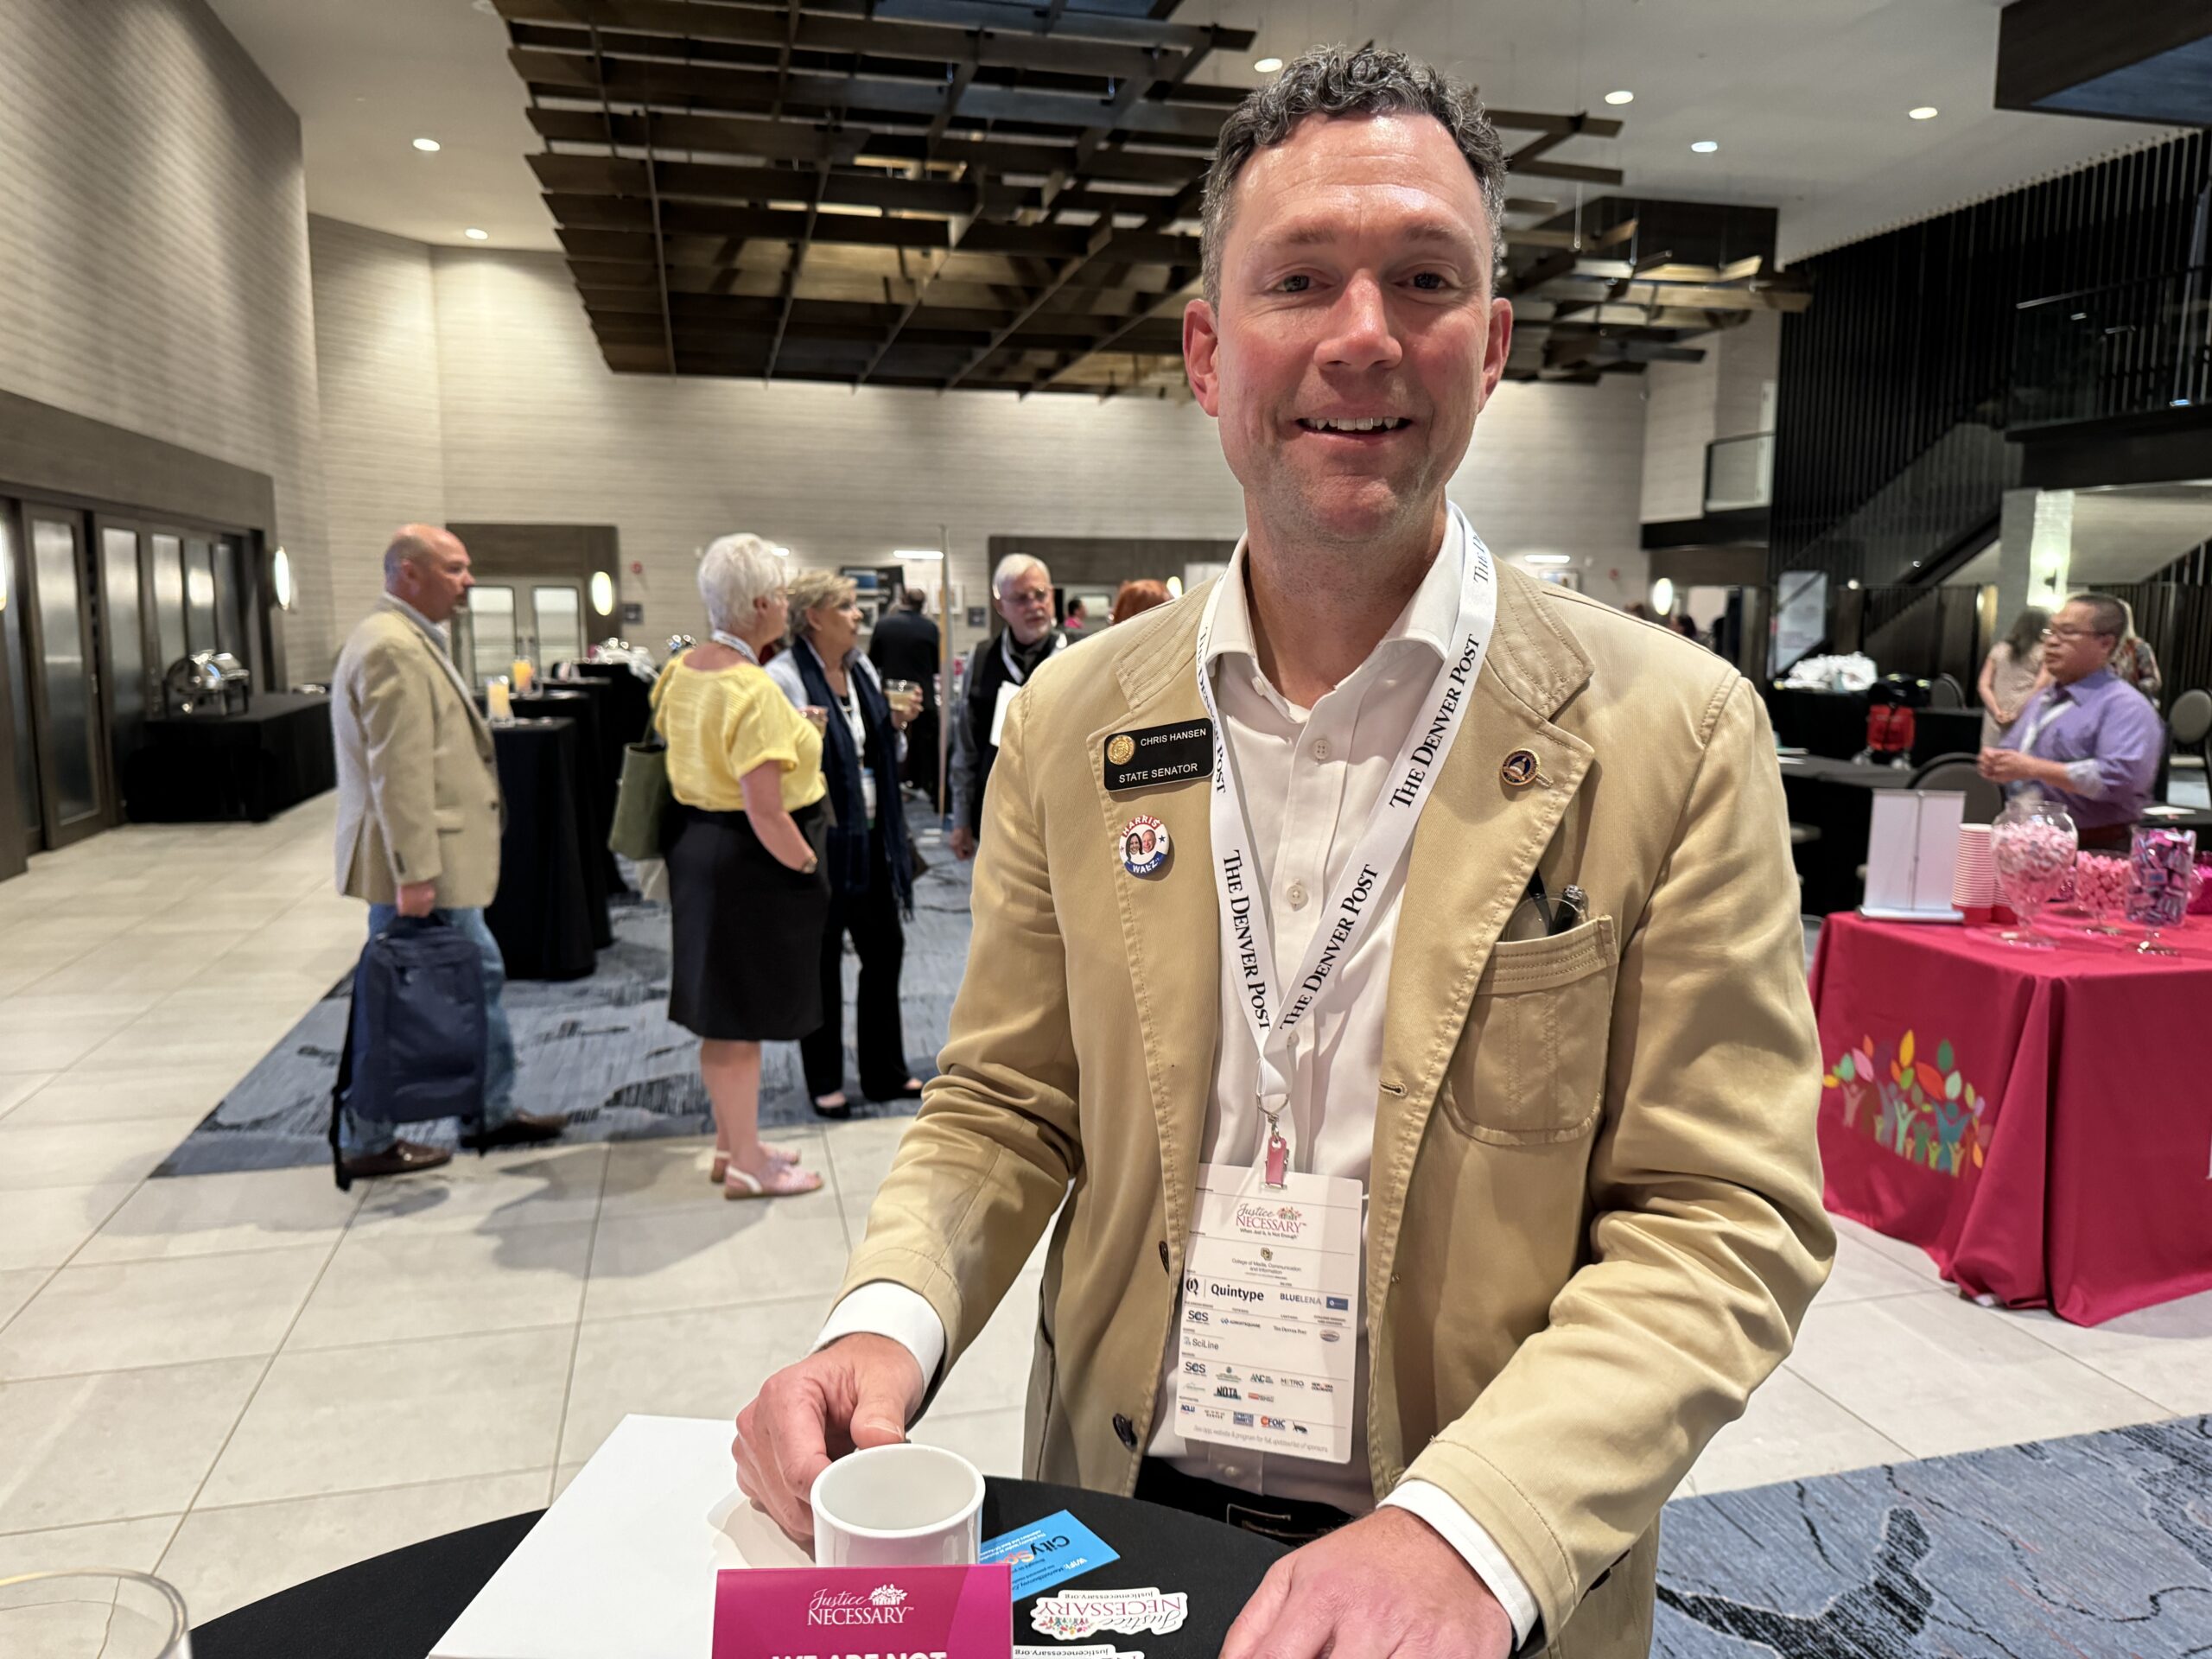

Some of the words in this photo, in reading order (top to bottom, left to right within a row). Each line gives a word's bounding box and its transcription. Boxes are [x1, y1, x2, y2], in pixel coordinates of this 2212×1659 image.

[1389, 768, 1426, 809] THE
[1410, 687, 1462, 768] DENVER
[1449, 633, 1479, 687] POST
[1140, 734, 1167, 747] CHRIS
[1169, 728, 1207, 742] HANSEN
[1118, 770, 1149, 784] STATE
[1151, 762, 1198, 779] SENATOR
[1216, 745, 1226, 794] POST
[1122, 814, 1160, 836] HARRIS
[1224, 849, 1243, 894] THE
[1230, 895, 1260, 979] DENVER
[1279, 995, 1313, 1031] THE
[1302, 917, 1356, 993] DENVER
[1340, 863, 1379, 917] POST
[1247, 980, 1271, 1032] POST
[1236, 1203, 1275, 1217] Justice
[1236, 1215, 1302, 1234] NECESSARY
[1211, 1283, 1264, 1302] Quintype
[1280, 1292, 1322, 1306] BLUELENA
[1192, 1338, 1219, 1350] SciLine
[809, 1588, 869, 1611] Justice
[1064, 1590, 1154, 1600] justicenecessary.org
[806, 1606, 907, 1626] NECESSARY
[1036, 1596, 1181, 1618] NECESSARY
[1099, 1609, 1181, 1632] Justice
[1014, 1647, 1109, 1656] justicenecessary.org
